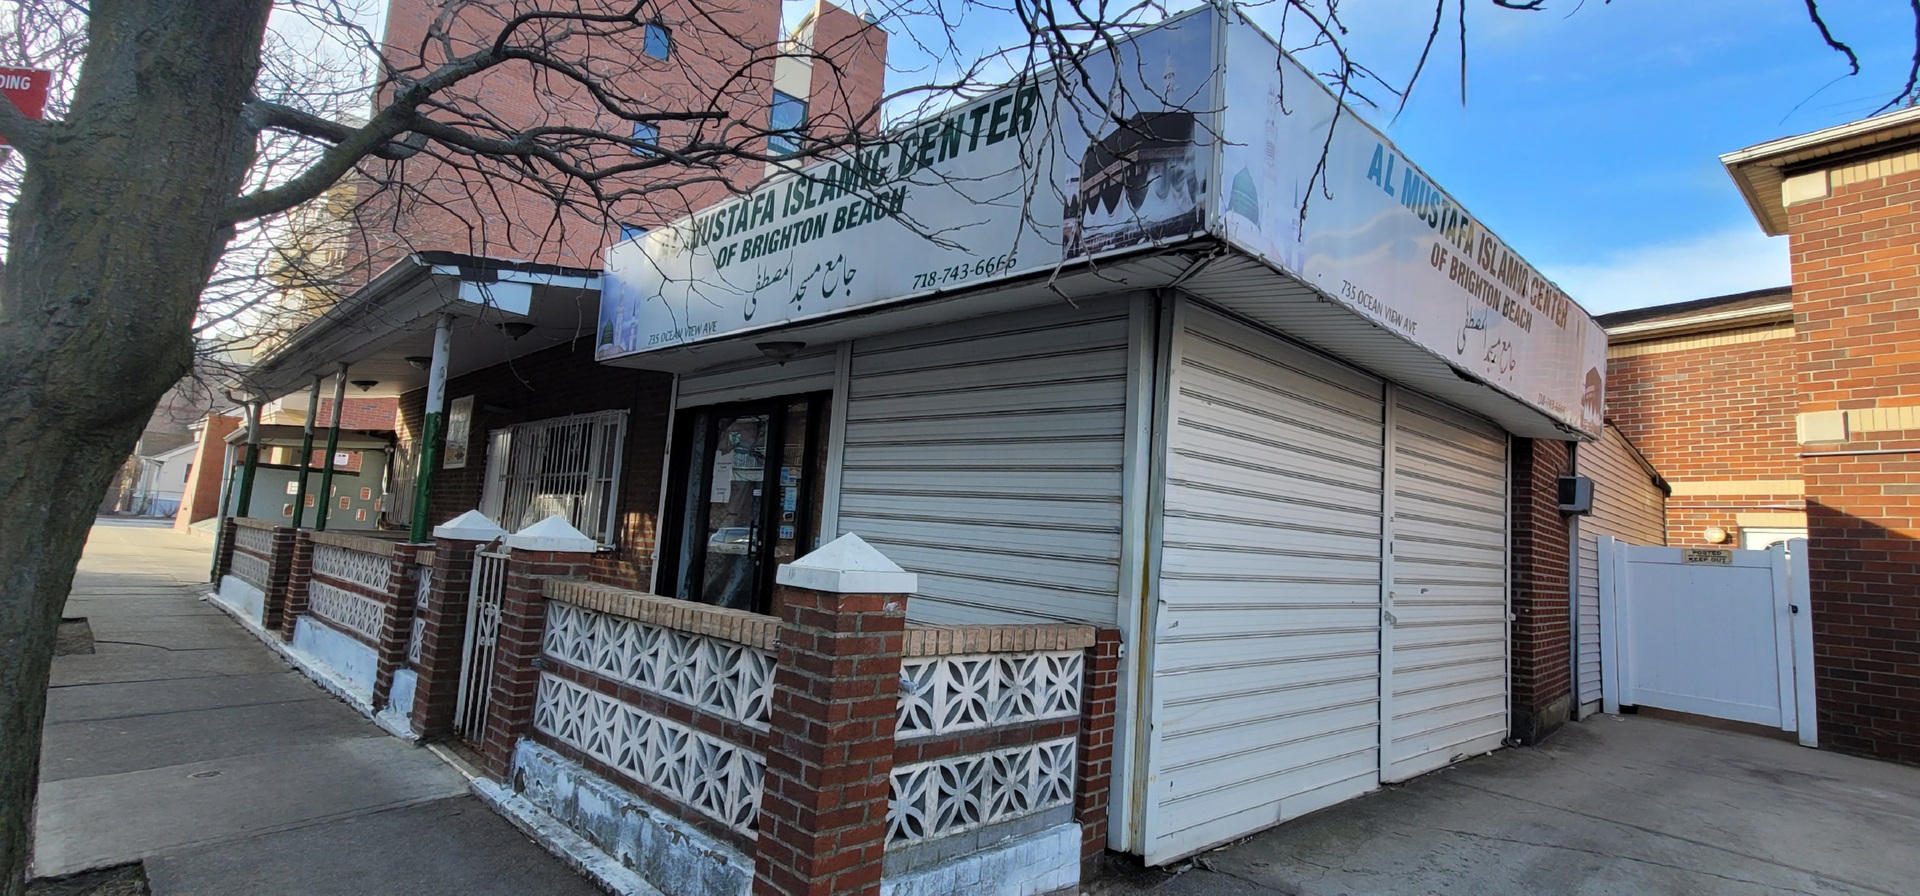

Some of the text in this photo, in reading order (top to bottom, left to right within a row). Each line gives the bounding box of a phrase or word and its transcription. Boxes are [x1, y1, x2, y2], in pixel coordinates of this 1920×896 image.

[782, 144, 890, 218] ISLAMIC
[898, 87, 1039, 176] CENTER
[716, 243, 738, 270] OF
[740, 212, 828, 263] BRIGHTON
[832, 185, 907, 234] BEACH
[1367, 143, 1568, 329] AL MUSTAFA ISLAMIC CENTER
[789, 263, 821, 311] مسجد
[822, 253, 857, 298] جامع
[912, 251, 1018, 290] 718-743-6666
[1430, 242, 1533, 333] OF BRIGHTON BEACH
[648, 321, 718, 346] 735 OCEAN VIEW AVE
[1342, 280, 1417, 335] 735 OCEAN VIEW AVE
